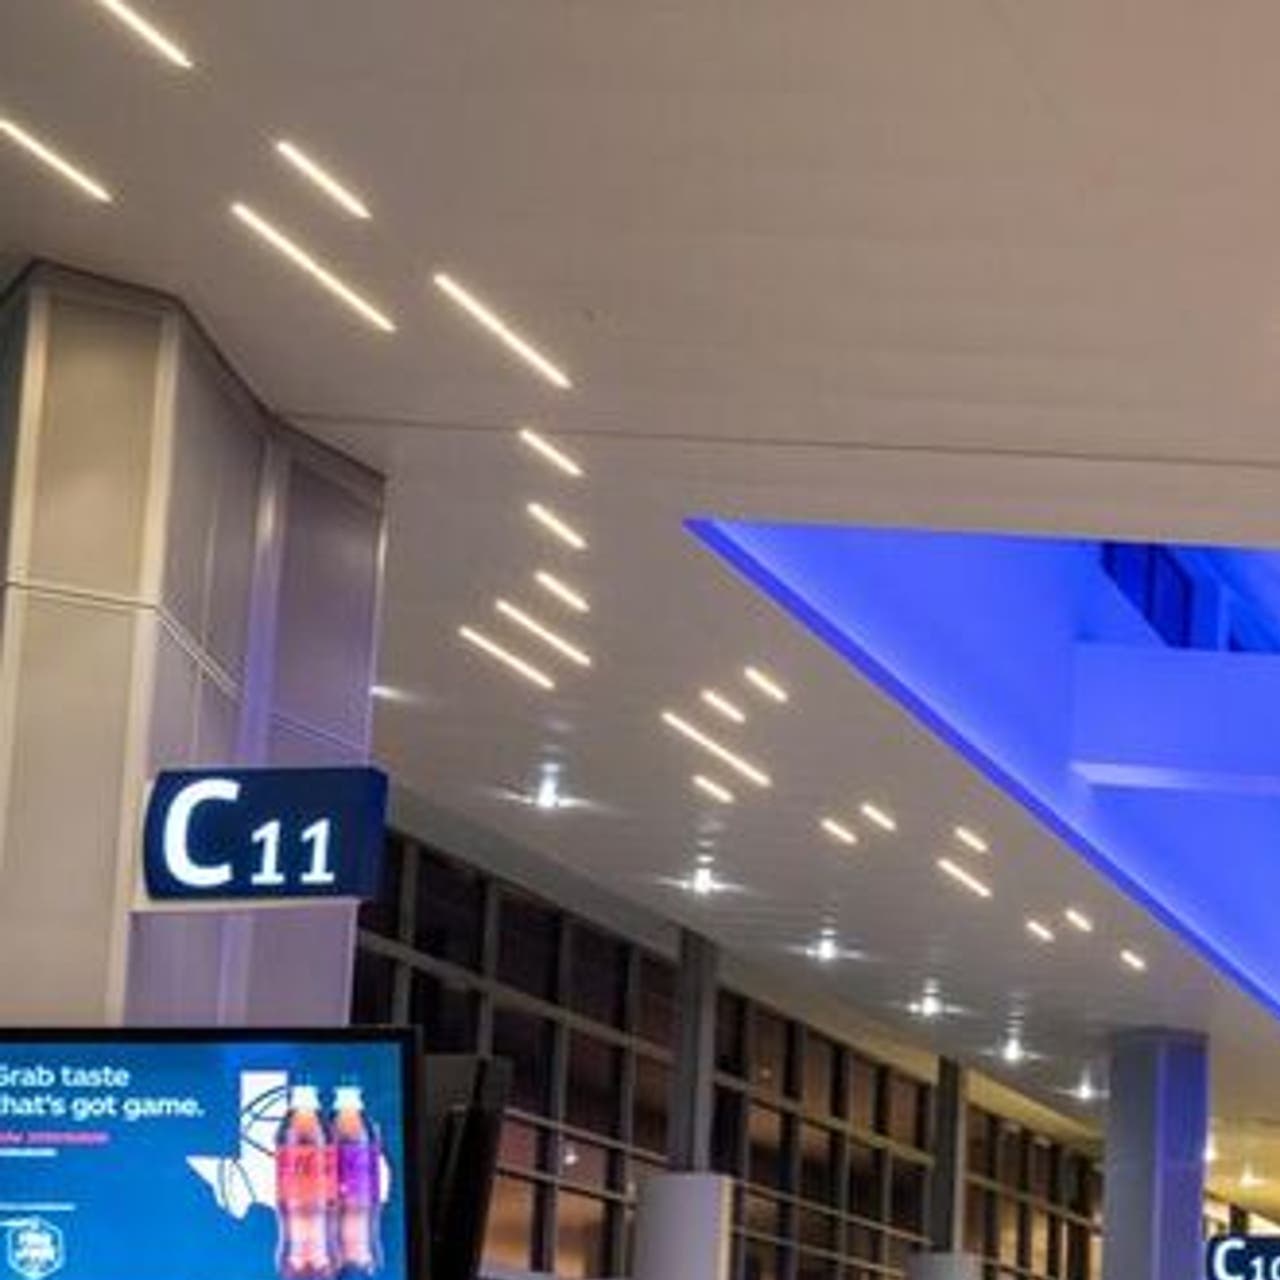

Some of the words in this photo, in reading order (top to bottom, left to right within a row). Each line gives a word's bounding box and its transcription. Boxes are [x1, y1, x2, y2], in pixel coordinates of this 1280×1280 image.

[61, 1065, 130, 1087] taste
[0, 1093, 66, 1115] hat's
[71, 1096, 117, 1121] got
[123, 1096, 205, 1121] game.
